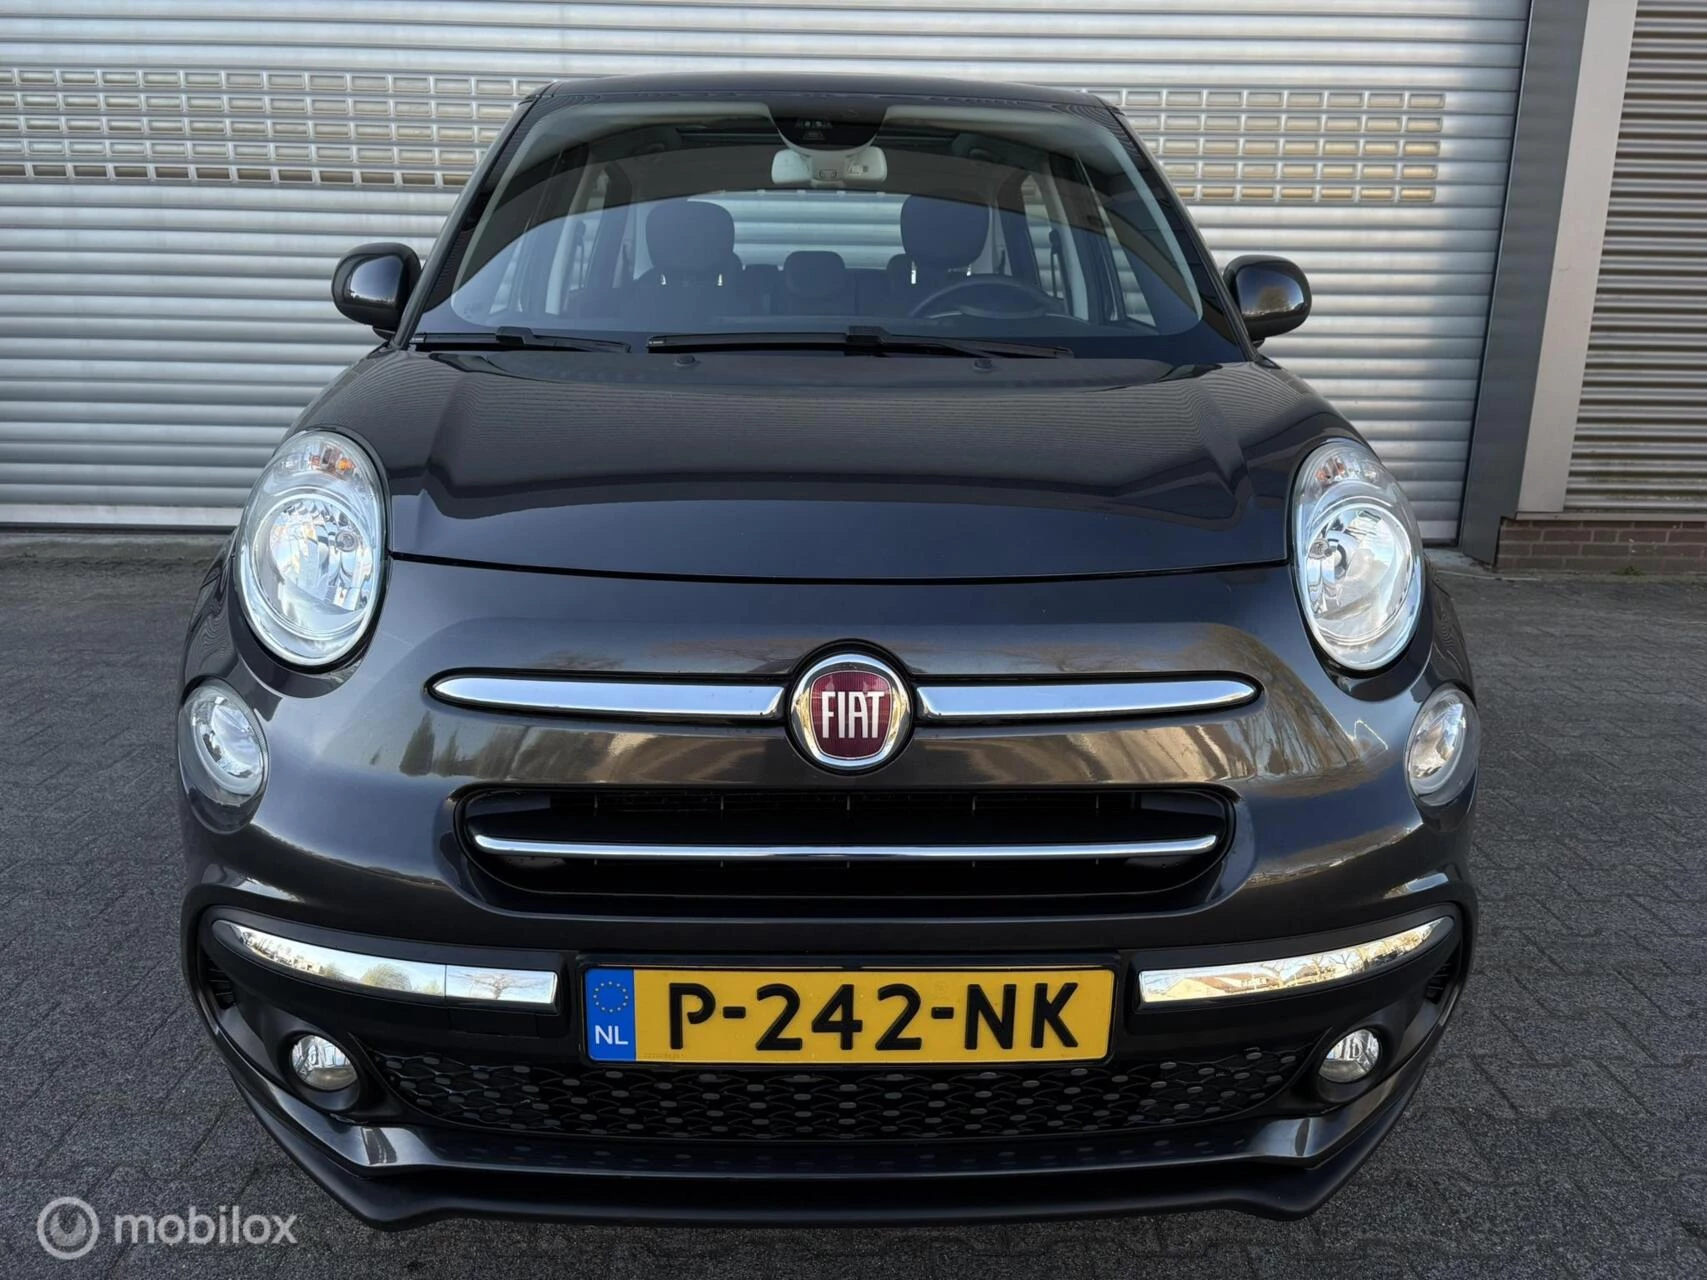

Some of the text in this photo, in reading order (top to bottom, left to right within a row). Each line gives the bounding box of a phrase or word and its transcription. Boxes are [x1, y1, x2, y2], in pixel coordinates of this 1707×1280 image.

[821, 691, 885, 739] FIAT
[594, 1025, 629, 1045] NL
[668, 982, 1079, 1051] P-242-NK
